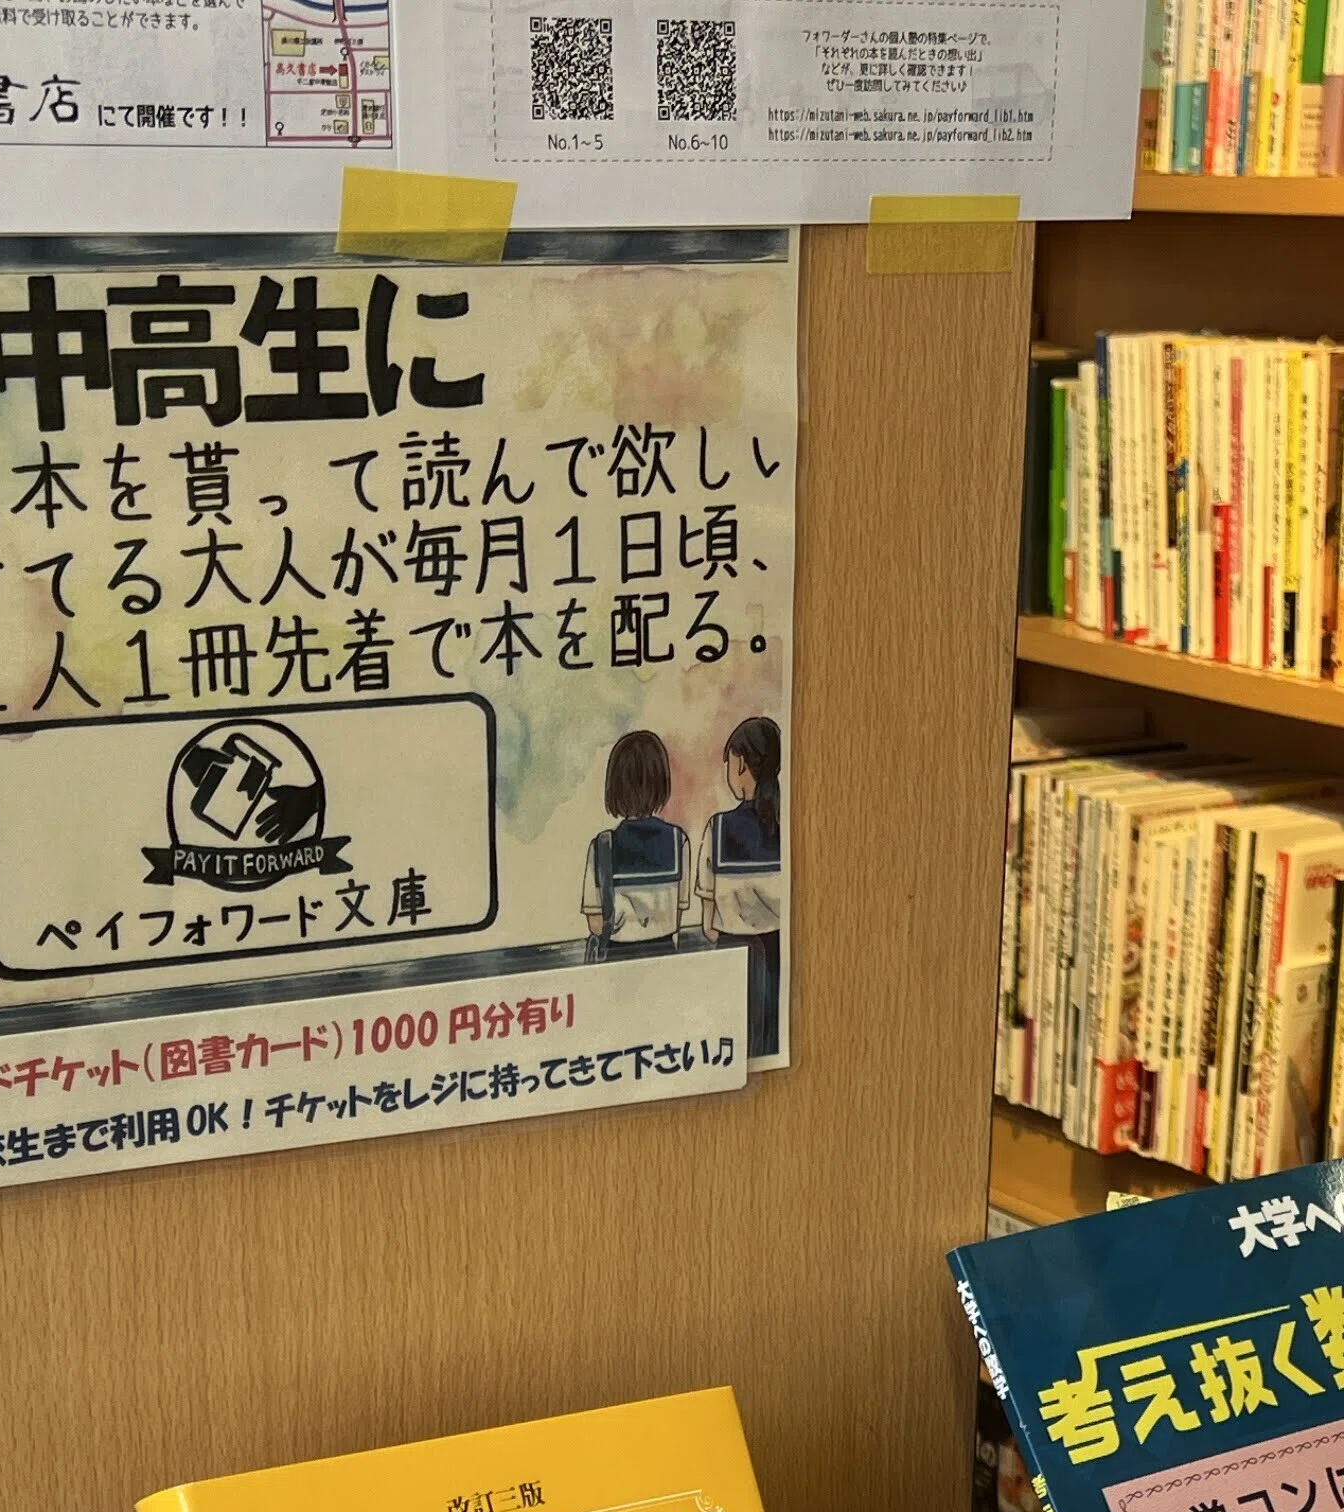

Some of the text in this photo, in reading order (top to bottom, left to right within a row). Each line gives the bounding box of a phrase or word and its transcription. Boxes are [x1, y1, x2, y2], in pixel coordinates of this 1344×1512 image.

[173, 844, 327, 878] PAY IT FORWARD
[33, 869, 435, 951] ペイフォワード文庫
